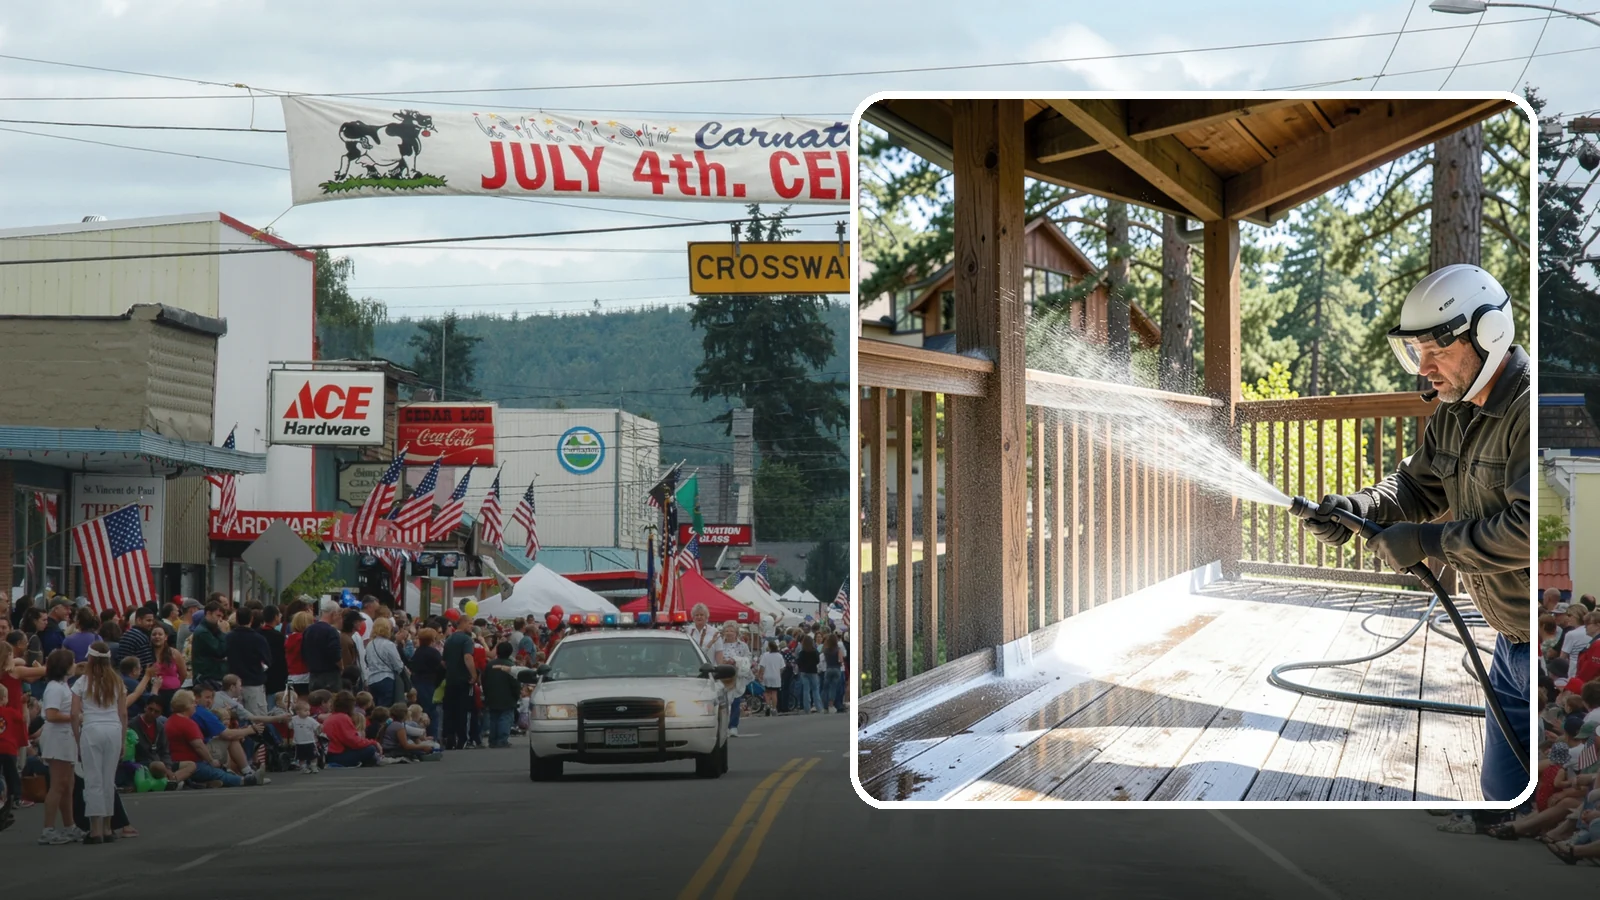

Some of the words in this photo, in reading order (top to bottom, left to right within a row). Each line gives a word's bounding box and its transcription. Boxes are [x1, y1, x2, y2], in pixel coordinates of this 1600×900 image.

[481, 141, 605, 192] JULY
[632, 150, 746, 197] 4th.
[697, 254, 850, 280] CROSSWA
[283, 380, 373, 420] ACE
[406, 409, 452, 421] CEDAR
[283, 421, 371, 437] Hardware
[416, 428, 477, 447] Coca-Cola
[353, 467, 387, 480] Simpl
[83, 484, 93, 494] St.
[95, 485, 124, 495] Vincent
[126, 485, 136, 495] de
[137, 486, 155, 495] Paul
[212, 516, 331, 535] HARDARE
[688, 526, 741, 535] CRNATION
[699, 535, 730, 543] GLASS
